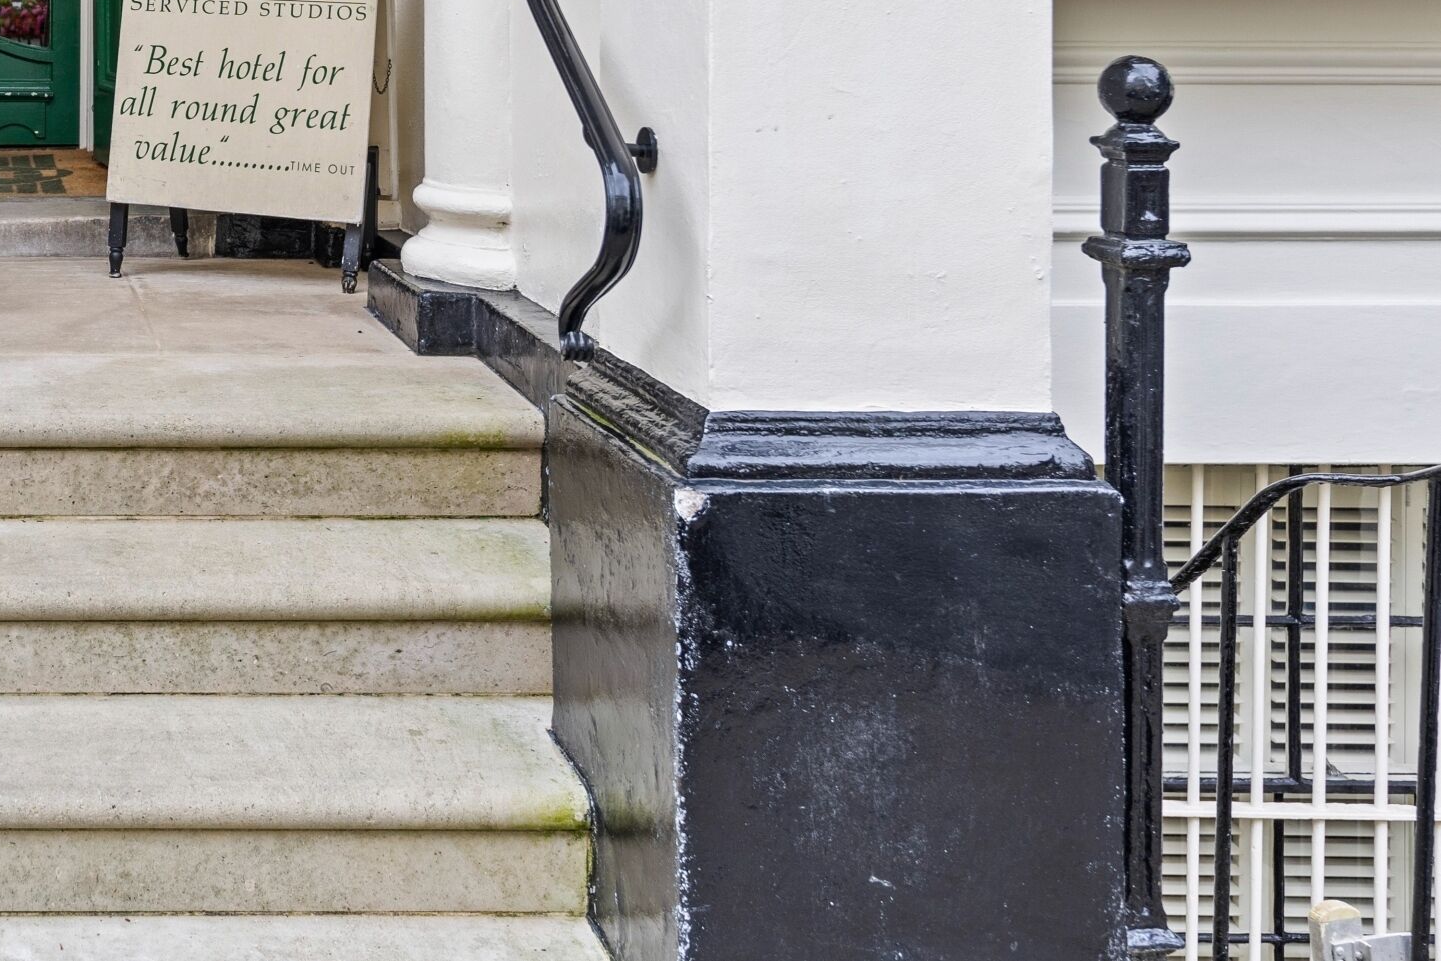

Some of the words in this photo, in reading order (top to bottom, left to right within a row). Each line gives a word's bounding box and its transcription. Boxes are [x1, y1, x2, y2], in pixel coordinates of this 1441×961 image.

[259, 2, 367, 21] STUDIOS
[217, 48, 286, 82] hotel
[296, 53, 345, 91] for
[120, 86, 157, 117] all
[170, 93, 260, 124] round
[269, 103, 351, 135] great
[290, 161, 321, 174] TIME
[328, 164, 356, 176] OUT
